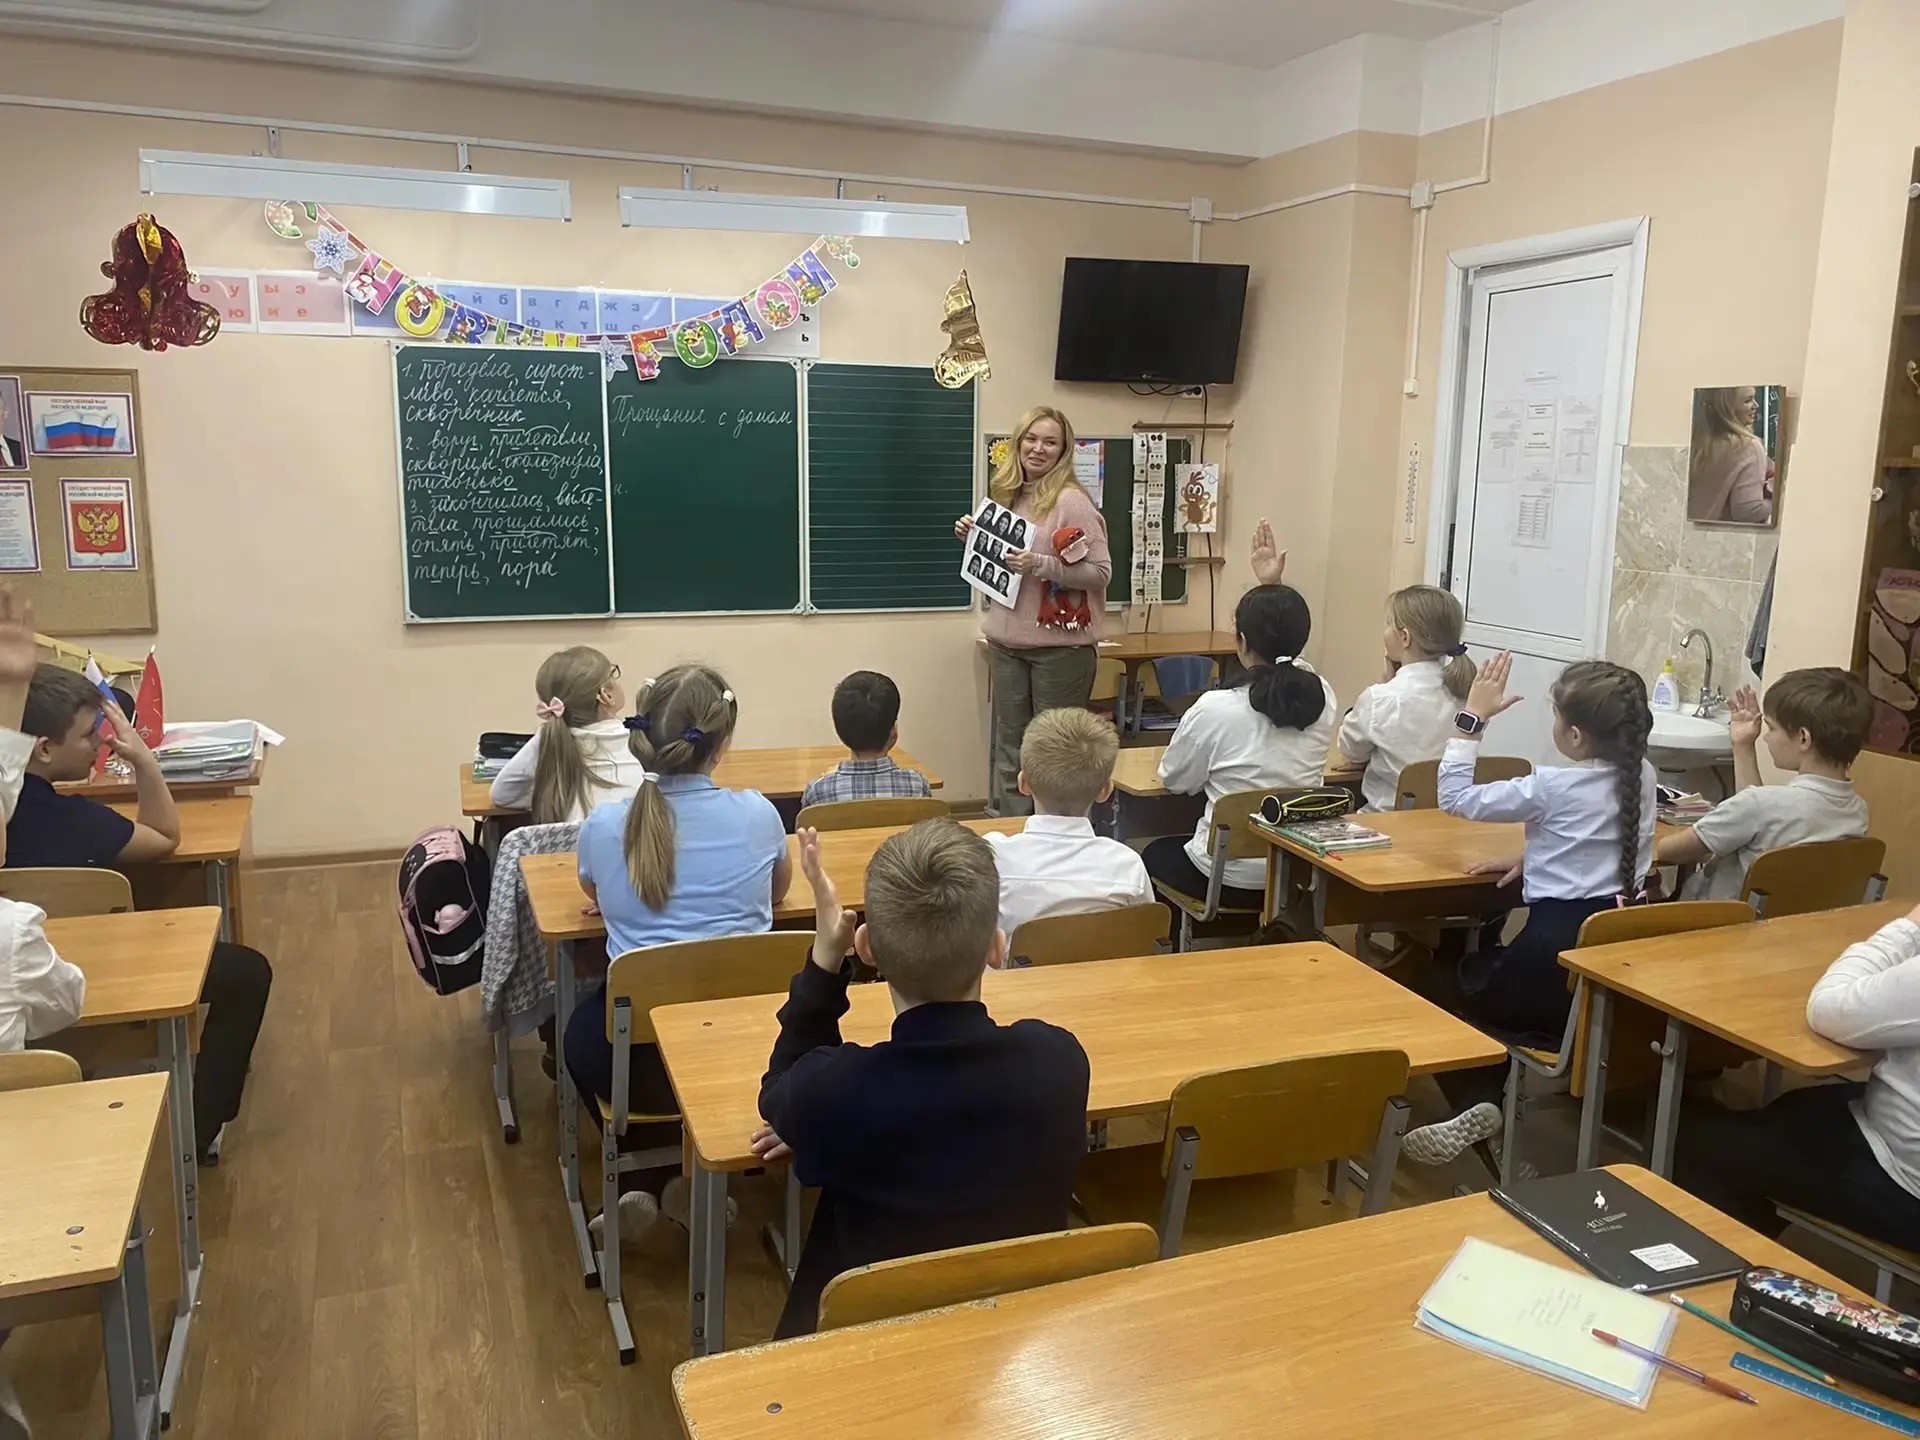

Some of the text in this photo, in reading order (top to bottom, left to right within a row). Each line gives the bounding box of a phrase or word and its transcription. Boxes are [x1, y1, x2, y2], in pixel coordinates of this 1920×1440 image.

[229, 285, 240, 298] у
[264, 284, 306, 295] ы э
[472, 291, 482, 304] й
[498, 292, 508, 305] б
[528, 297, 589, 311] в г д
[229, 308, 245, 319] ю
[268, 307, 308, 318] и е
[604, 302, 641, 313] ж з
[629, 250, 838, 381] ГОДОМ
[799, 313, 810, 322] ъ
[526, 317, 589, 331] ф к т
[801, 333, 809, 342] ь
[405, 403, 526, 430] скворечник
[612, 395, 705, 436] Прощание
[719, 411, 728, 426] с
[408, 475, 515, 491] тихонько
[501, 559, 558, 589] пора
